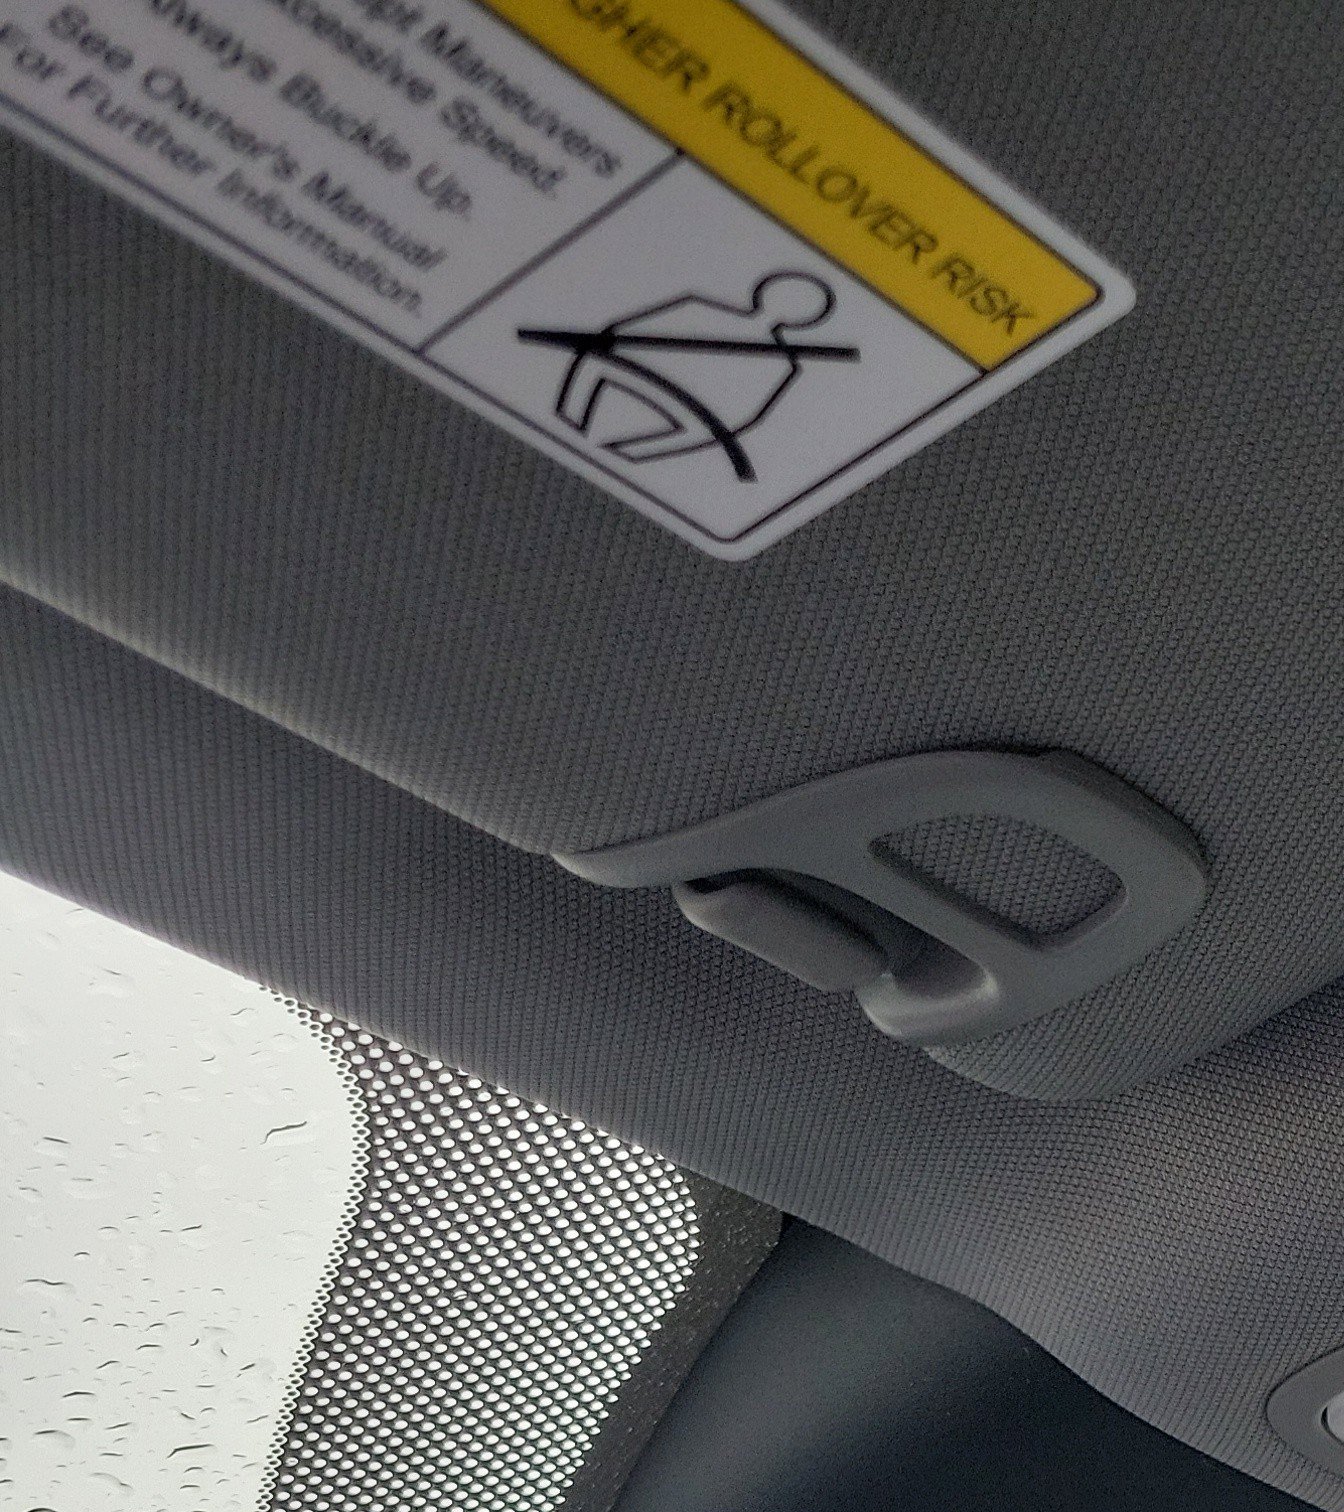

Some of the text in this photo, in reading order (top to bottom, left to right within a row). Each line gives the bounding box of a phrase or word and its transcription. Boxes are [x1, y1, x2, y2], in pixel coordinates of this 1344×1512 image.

[46, 5, 134, 74] See
[302, 168, 447, 272] Manual
[66, 74, 216, 178] Further
[280, 70, 412, 172] Buckle
[419, 20, 622, 178] Maneuvers
[702, 80, 938, 264] ROLLOVER
[934, 252, 1036, 338] RISK
